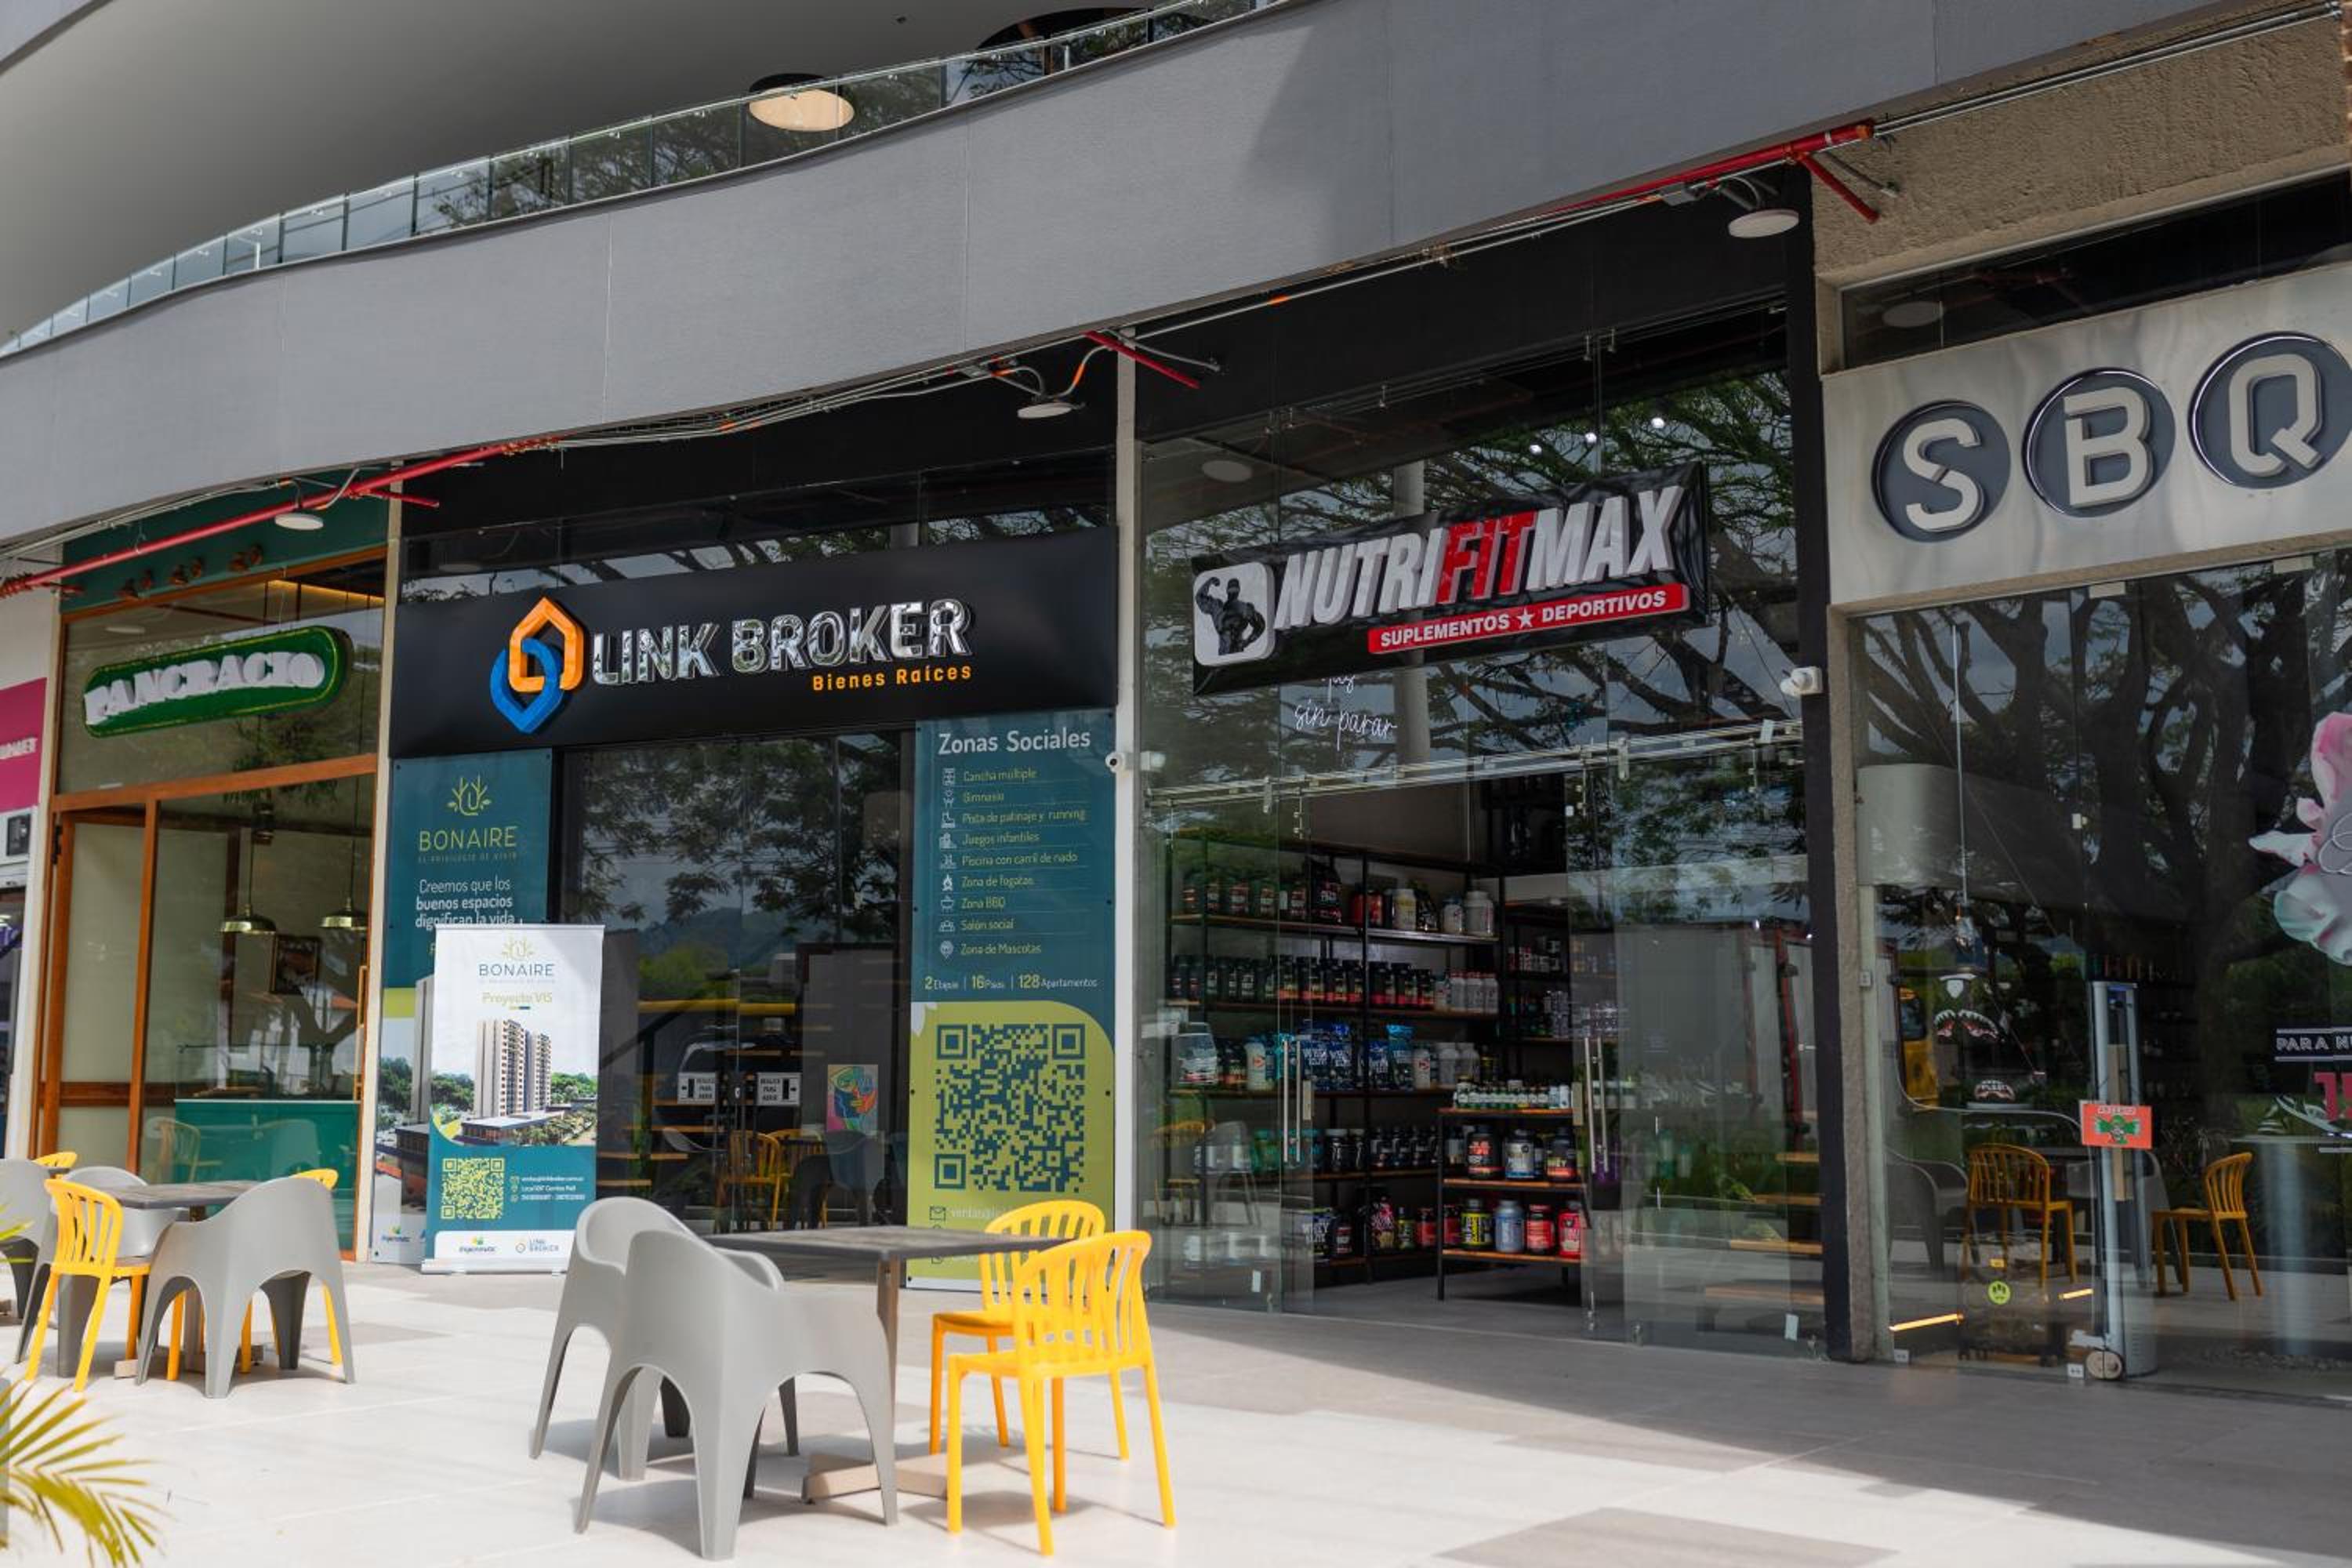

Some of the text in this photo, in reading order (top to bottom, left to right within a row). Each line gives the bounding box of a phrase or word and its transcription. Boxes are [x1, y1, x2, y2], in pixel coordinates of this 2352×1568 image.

[1274, 485, 1686, 630] NUTRIFITMAX
[1380, 590, 1666, 648] SUPLEMENTOS DEPORTIVOS
[593, 597, 972, 684] LINK BROKER
[84, 652, 325, 725] PANCRACIO
[812, 671, 886, 691] Bienes
[1337, 709, 1399, 751] parar
[938, 727, 1091, 755] Zonas Sociales
[1048, 810, 1086, 821] running
[419, 826, 518, 852] BONAIRE
[962, 831, 1040, 848] Juegos infantiles
[962, 855, 993, 866] Piscina
[996, 855, 1012, 865] con
[1040, 852, 1051, 863] de
[419, 875, 510, 895] Creemos que los
[961, 876, 984, 887] Zona
[985, 875, 998, 887] de
[416, 894, 514, 913] buenos espacios
[961, 898, 984, 909] Zona
[415, 909, 515, 931] dignifican la vida
[989, 918, 1014, 930] social
[960, 942, 1041, 955] Zona de Mascotas
[478, 963, 555, 977] BONAIRE
[971, 975, 985, 989] 16
[1019, 975, 1040, 989] 128
[1040, 978, 1098, 990] Apartamentos
[481, 992, 554, 1007] Proyecto VIS
[2276, 1036, 2329, 1051] PARA
